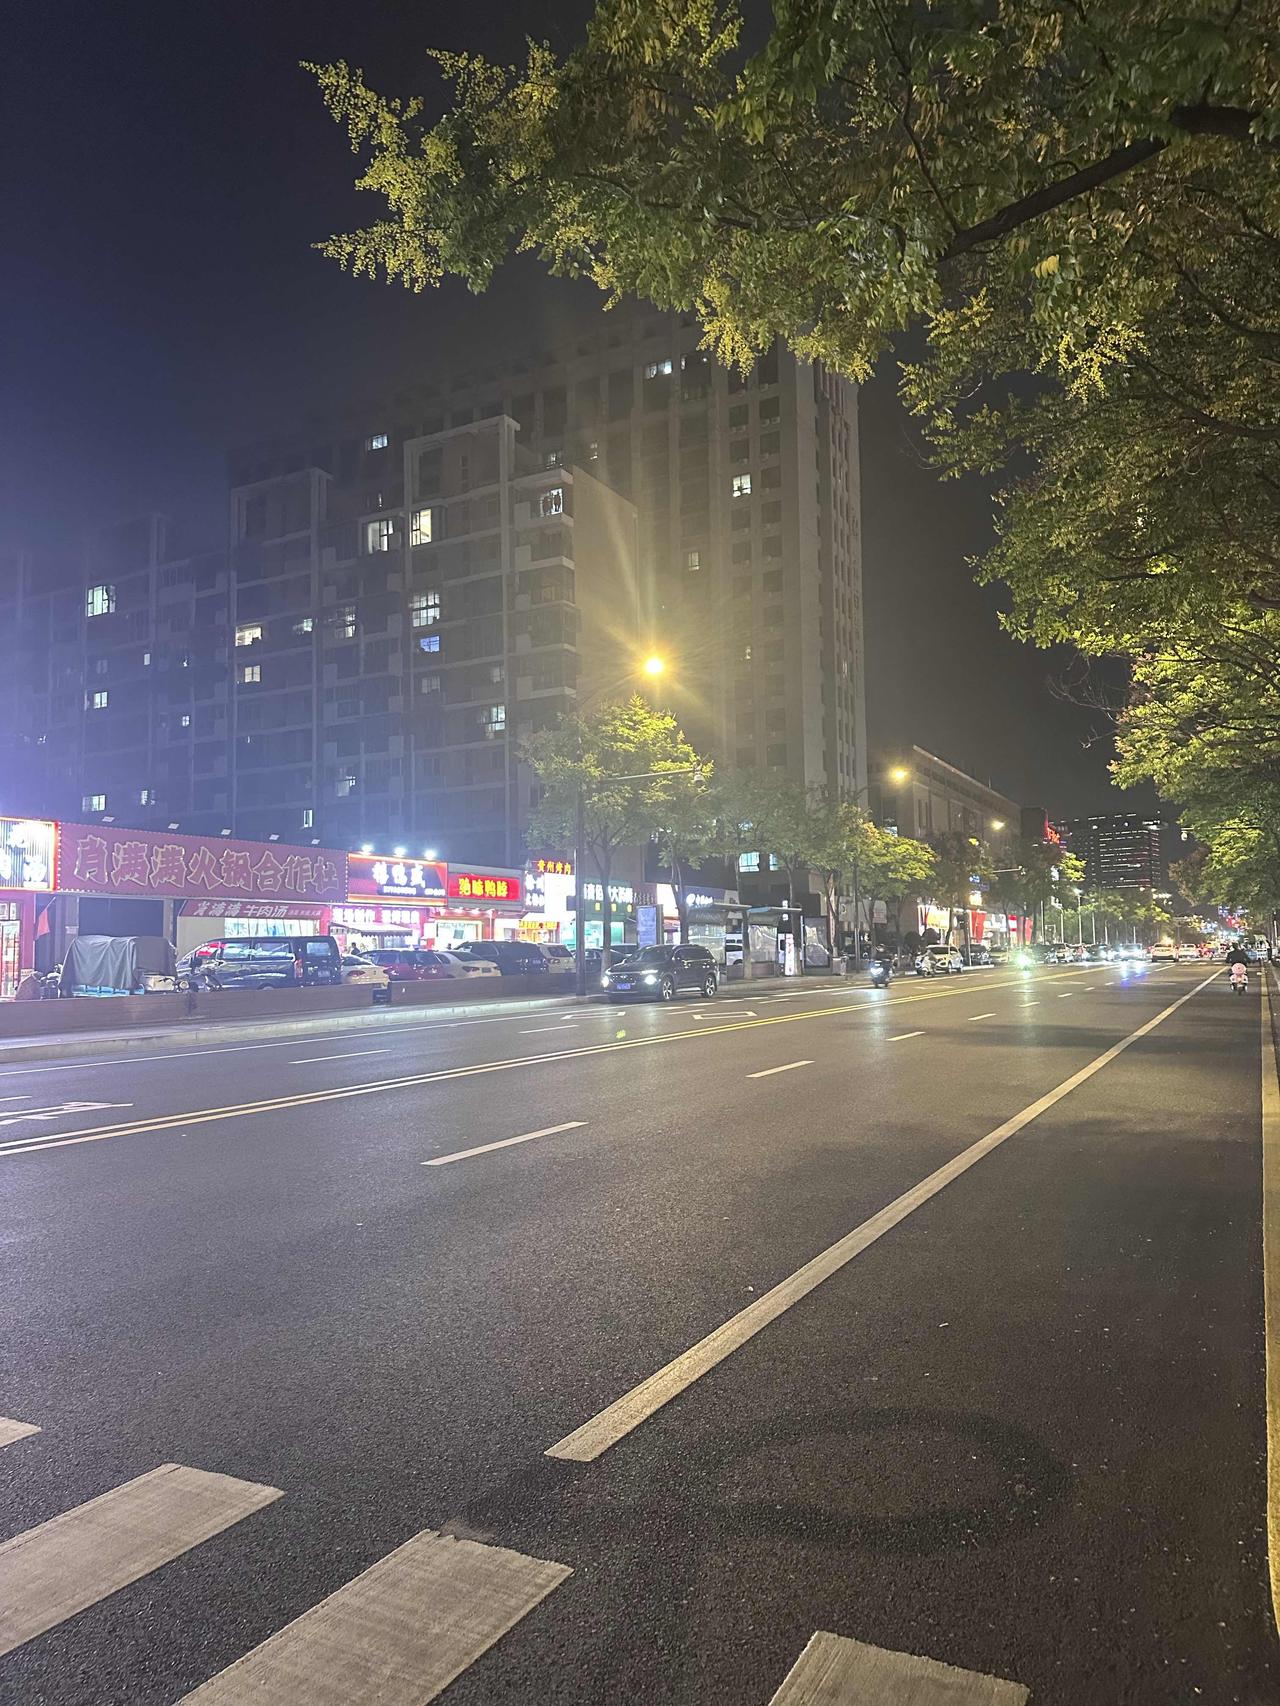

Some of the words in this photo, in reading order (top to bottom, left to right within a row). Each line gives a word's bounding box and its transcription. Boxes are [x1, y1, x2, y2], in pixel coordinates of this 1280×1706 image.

[73, 835, 340, 894] 肖满满火锅合作社
